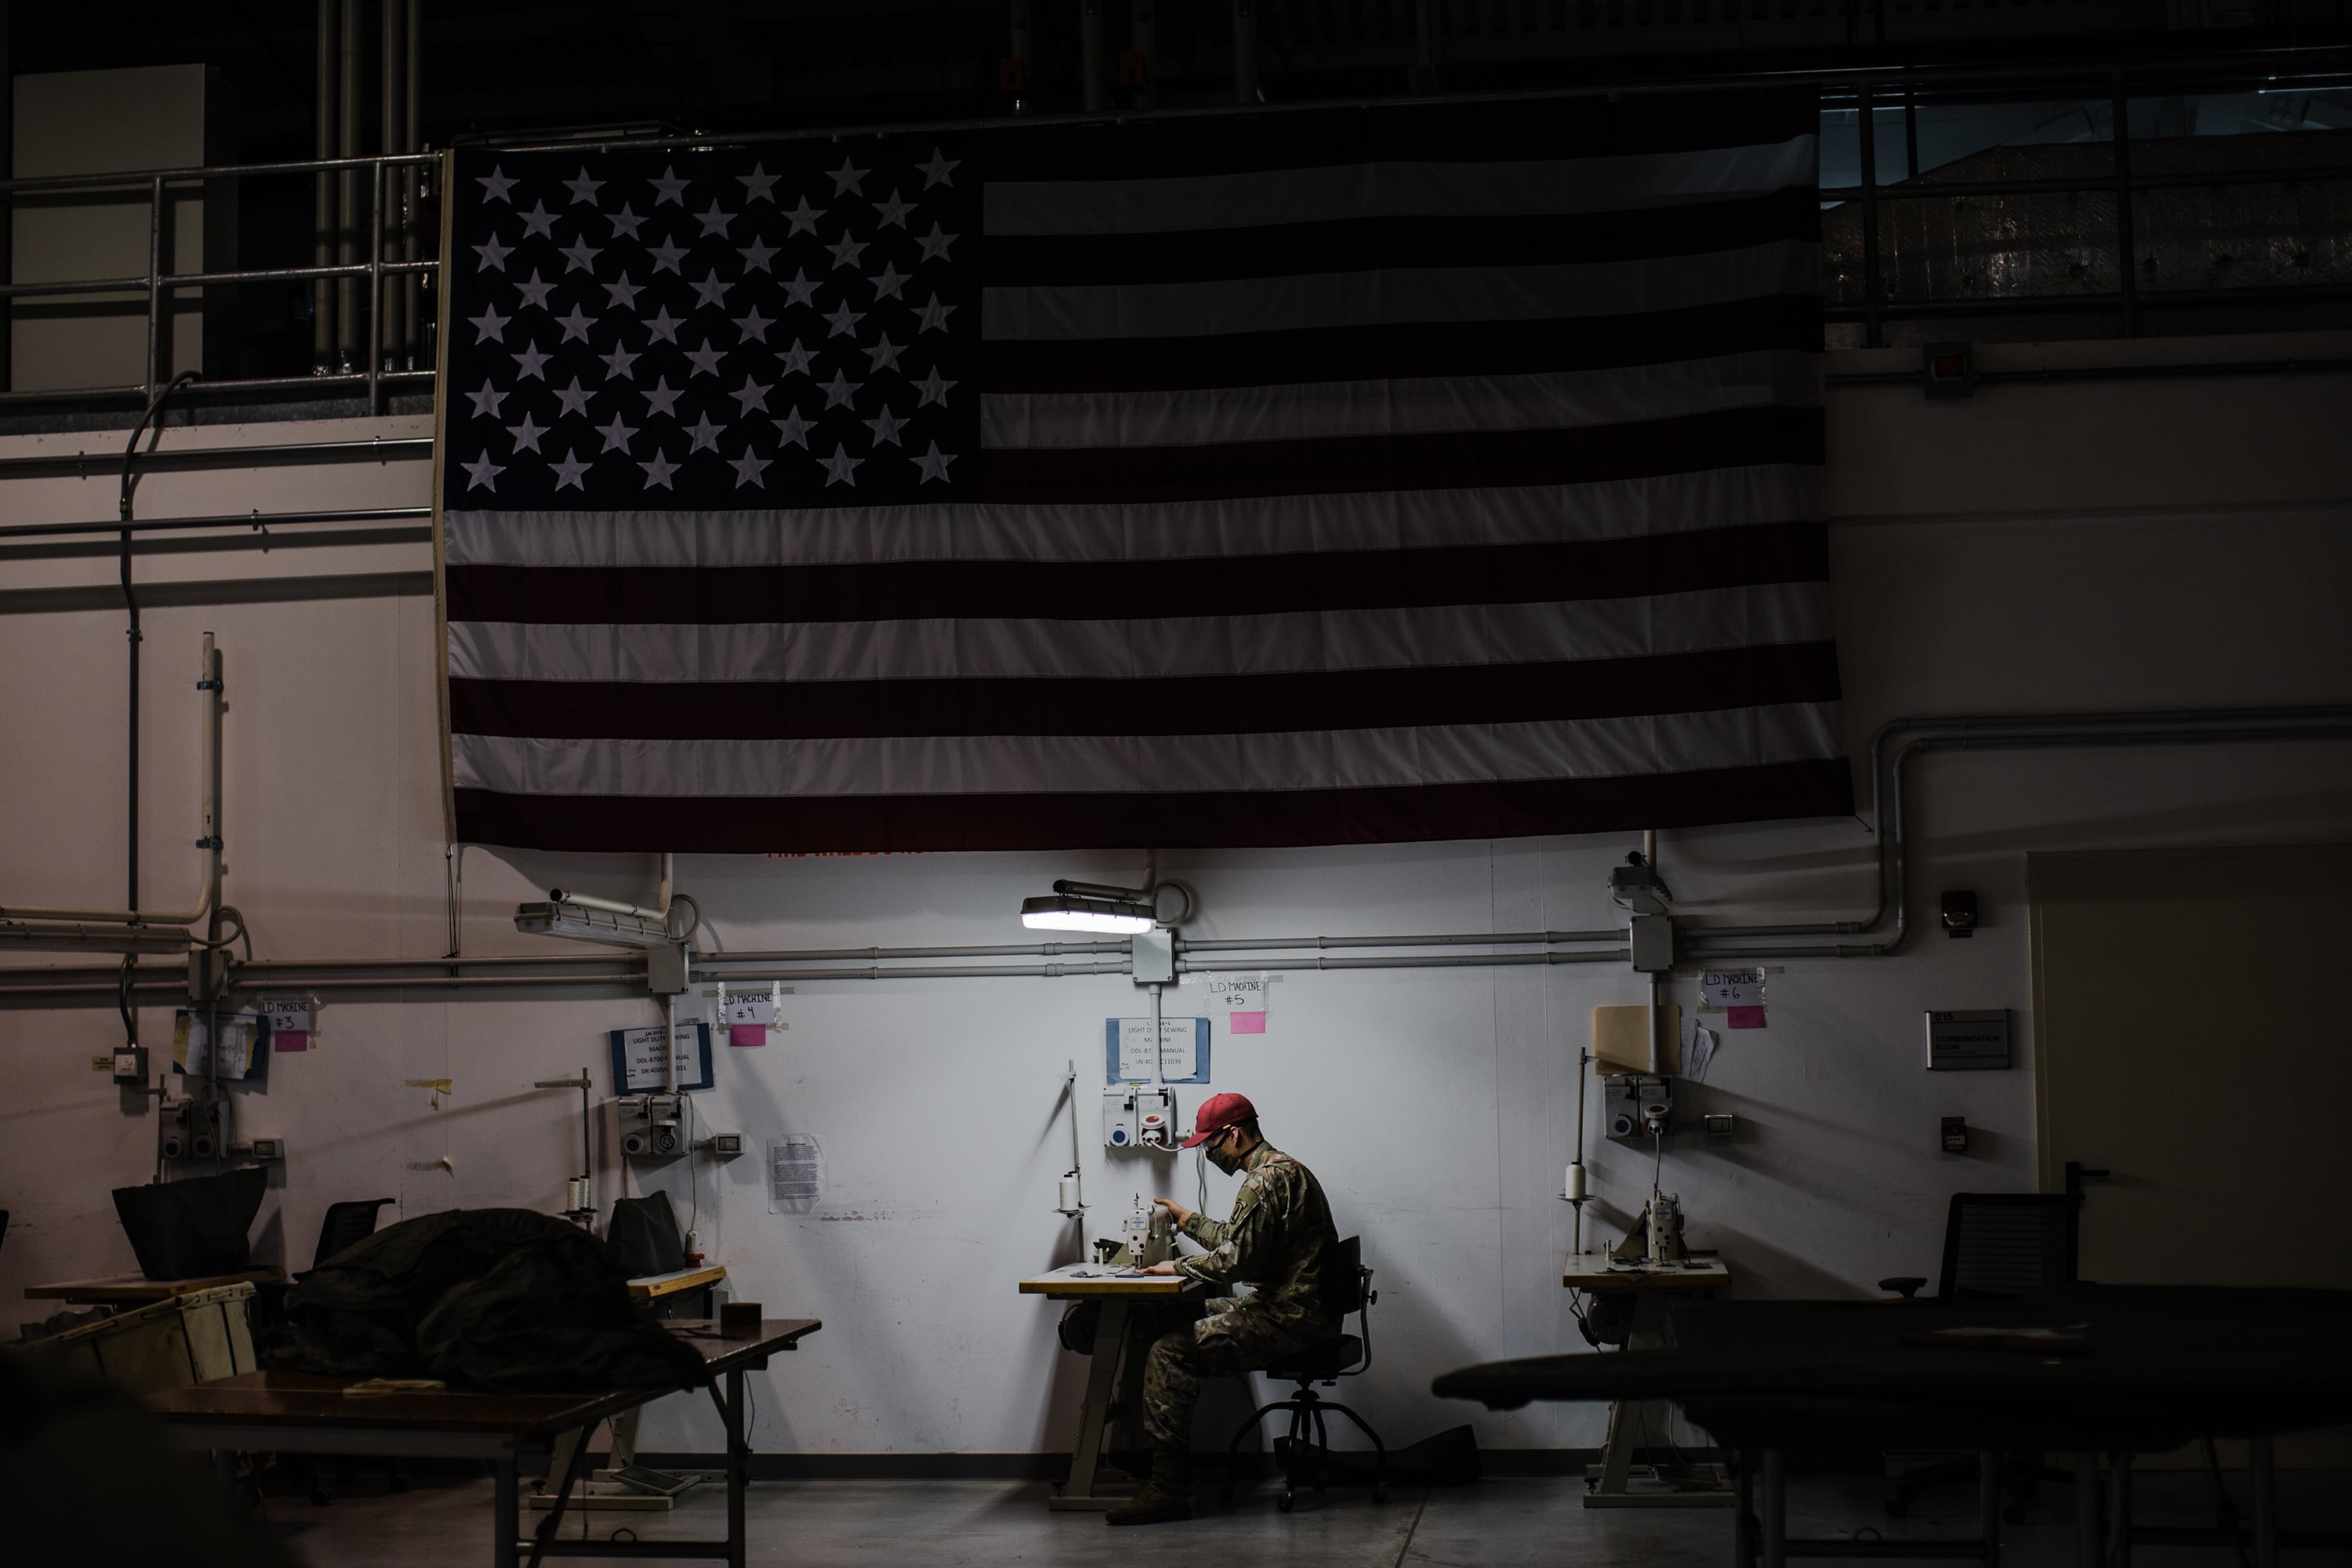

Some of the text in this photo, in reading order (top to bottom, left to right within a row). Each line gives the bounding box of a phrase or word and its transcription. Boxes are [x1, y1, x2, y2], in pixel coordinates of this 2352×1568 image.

[1723, 973, 1759, 985] MACHINE
[1228, 981, 1261, 992] MACHINE
[737, 993, 772, 1004] MACHINE
[263, 1002, 309, 1014] LD MACHINE
[1935, 1012, 1954, 1022] 015
